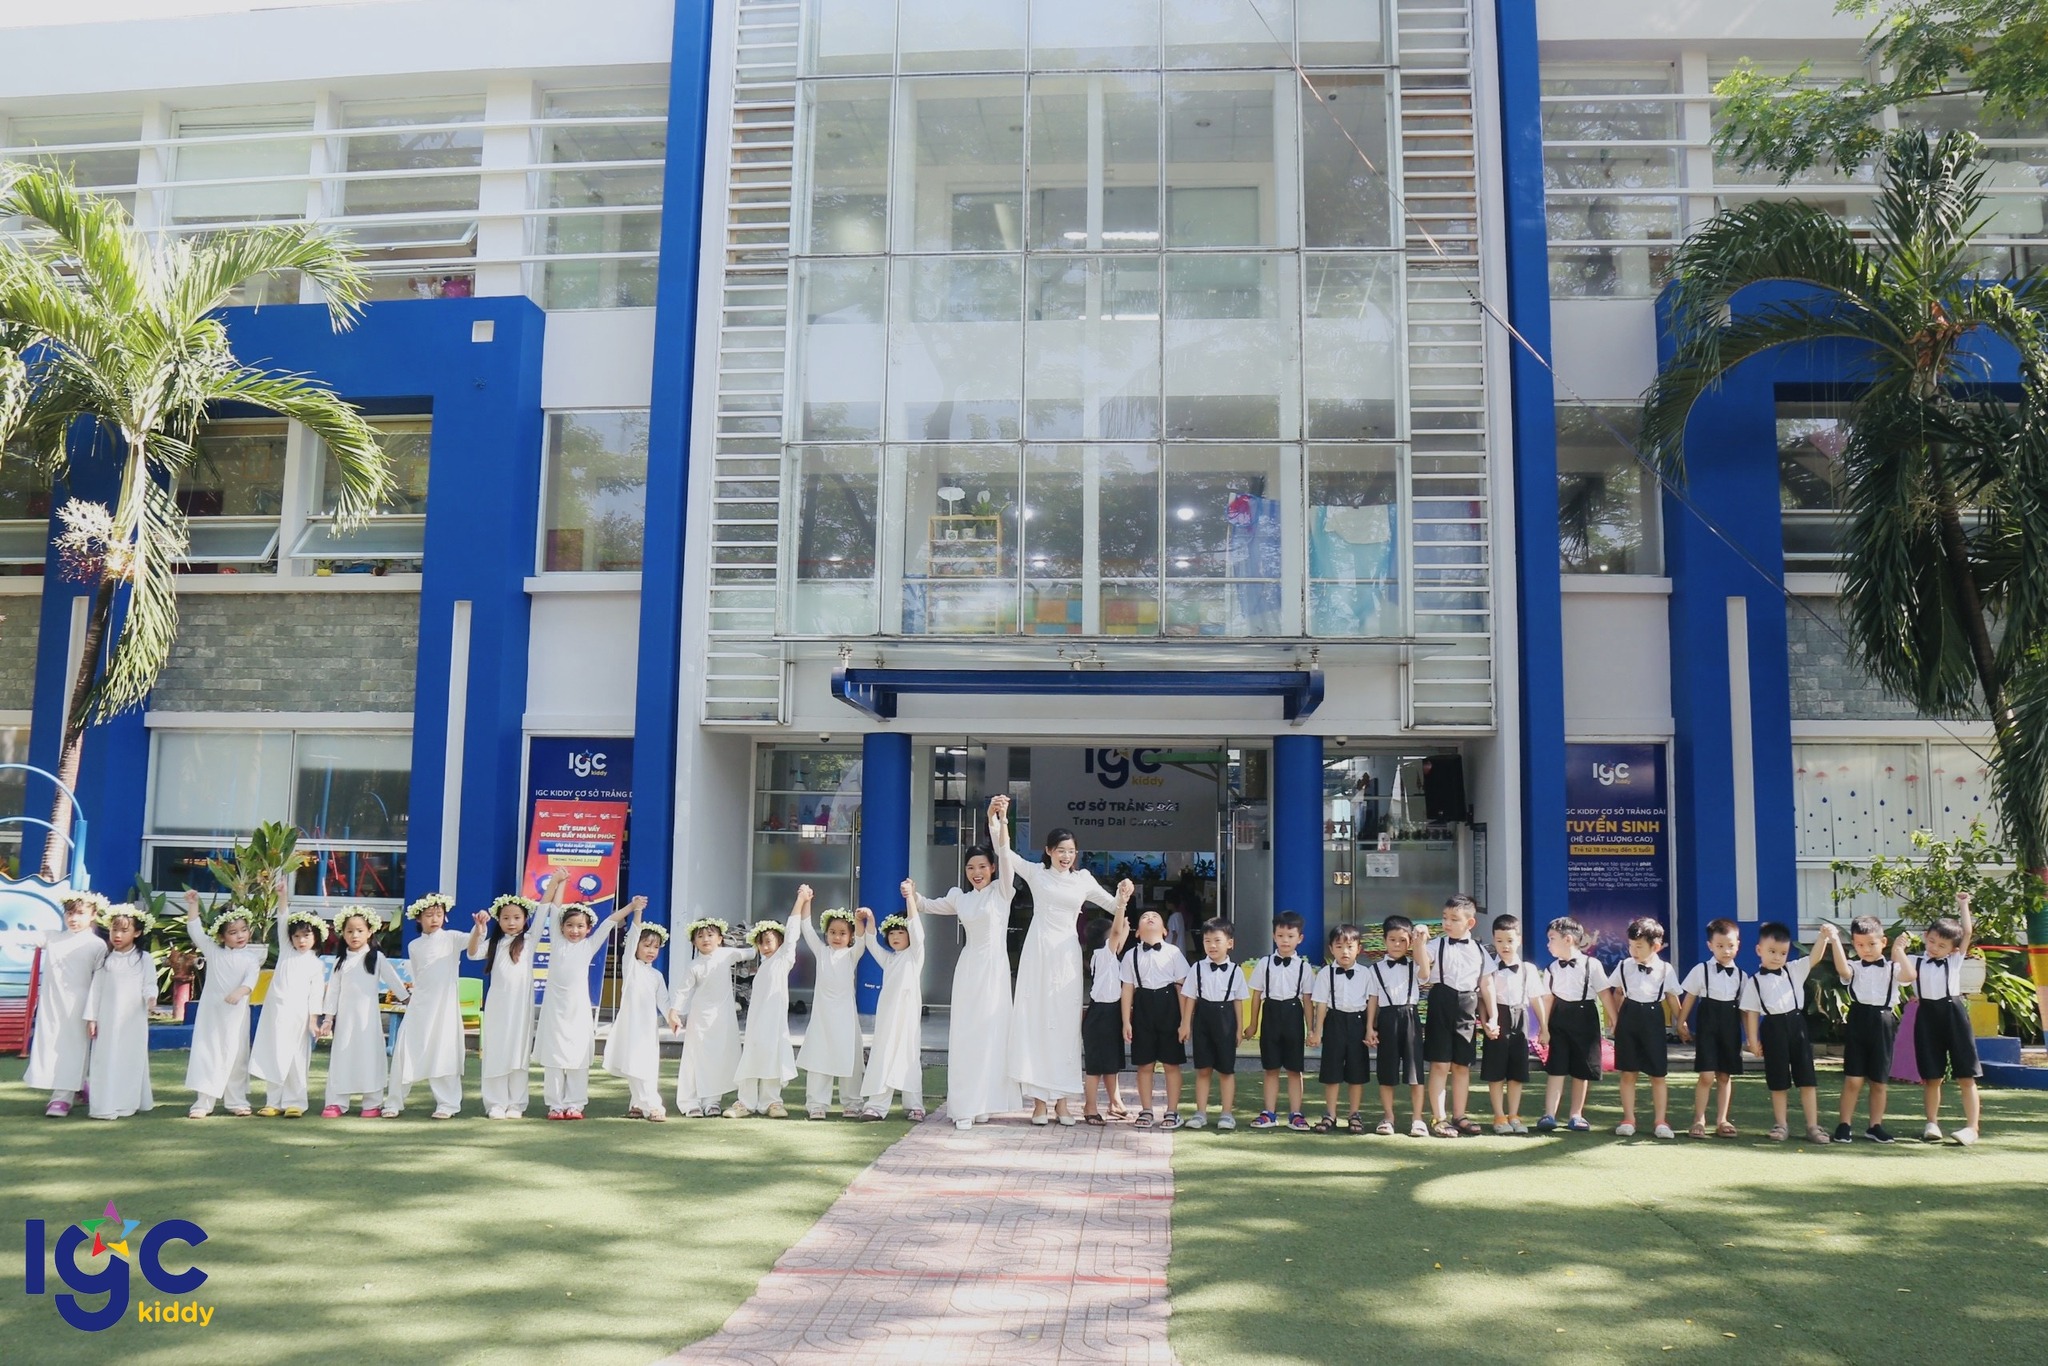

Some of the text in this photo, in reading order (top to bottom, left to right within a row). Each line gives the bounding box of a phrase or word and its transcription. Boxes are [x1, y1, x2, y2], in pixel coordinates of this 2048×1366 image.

[1132, 776, 1164, 788] kiddy
[588, 788, 599, 797] SỞ
[1068, 800, 1086, 811] CƠ
[1089, 798, 1106, 812] SỞ
[1614, 807, 1624, 815] SỞ
[1073, 817, 1104, 828] Trang
[1566, 815, 1660, 832] TUYỂN SINH
